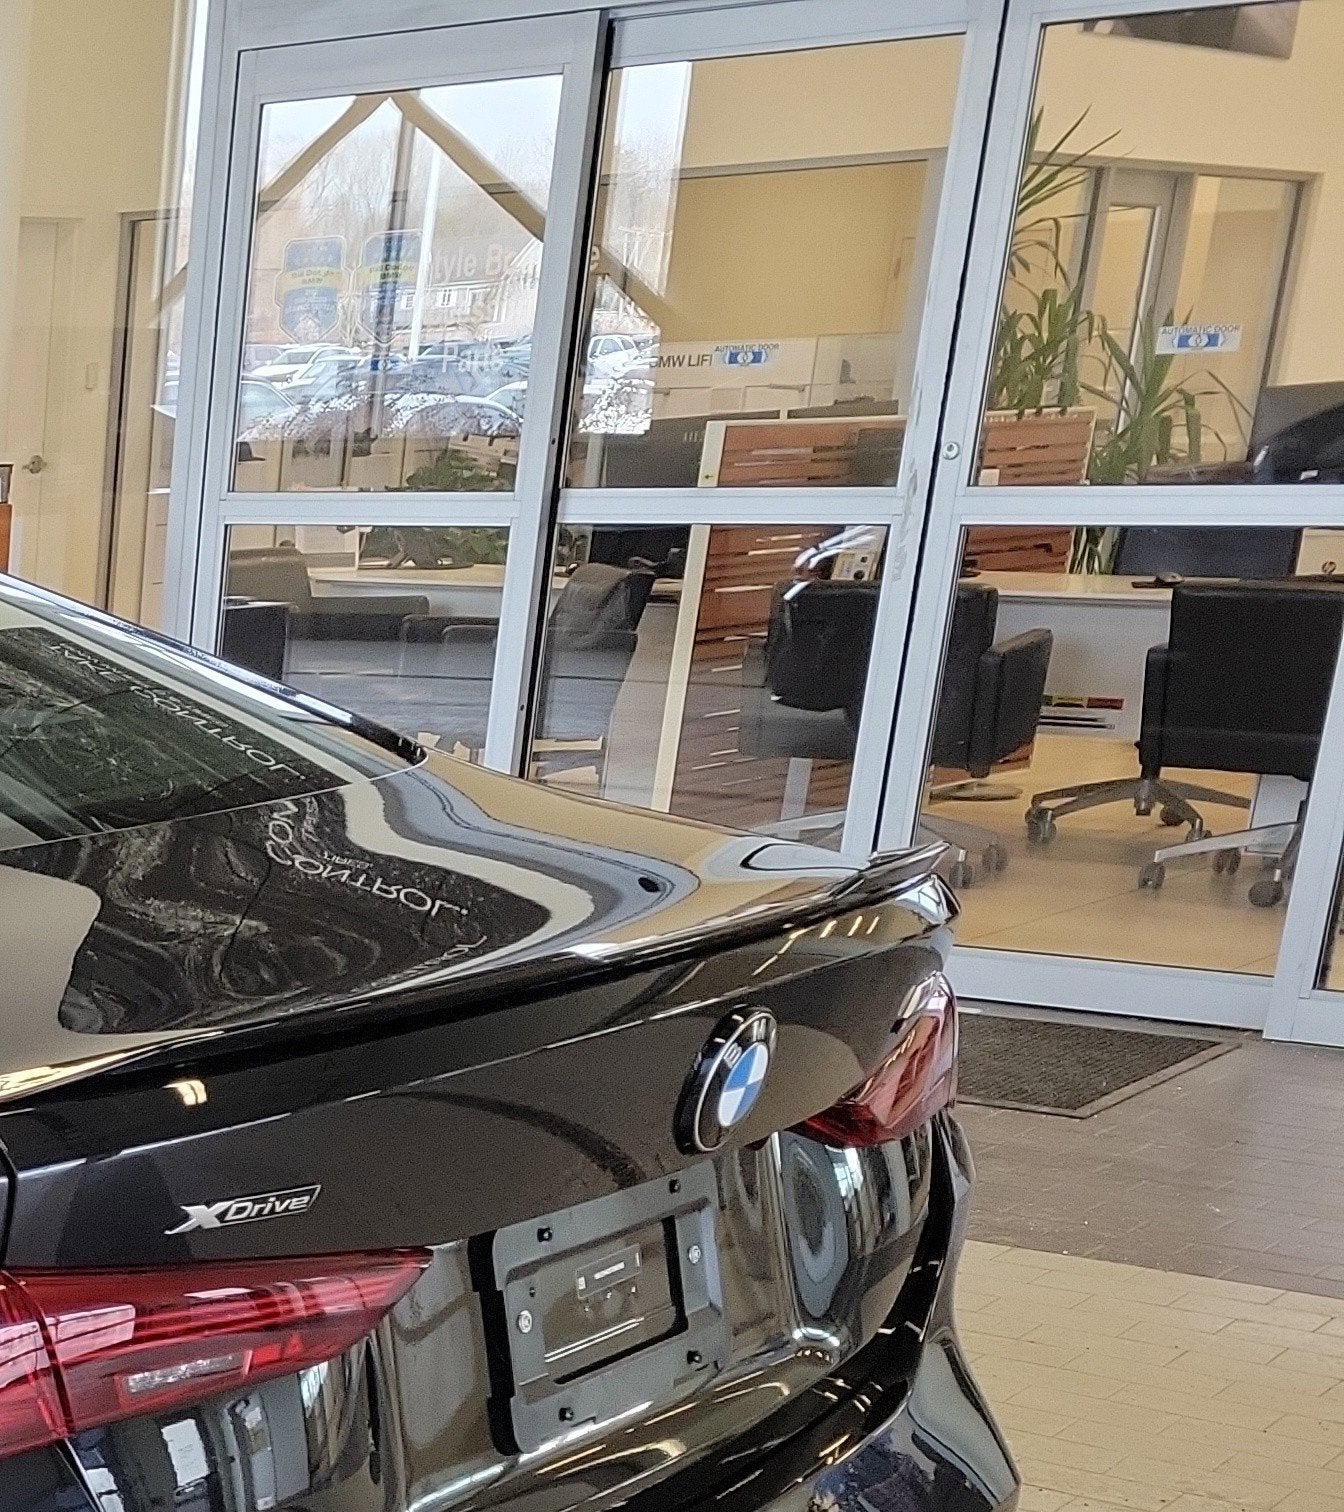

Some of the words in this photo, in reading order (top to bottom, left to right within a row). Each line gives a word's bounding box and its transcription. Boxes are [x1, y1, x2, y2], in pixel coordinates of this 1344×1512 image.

[1161, 325, 1212, 335] AUTOMATIC
[1214, 324, 1240, 333] DOOR
[714, 344, 757, 353] AUTOMATIC
[758, 343, 780, 351] DOOR
